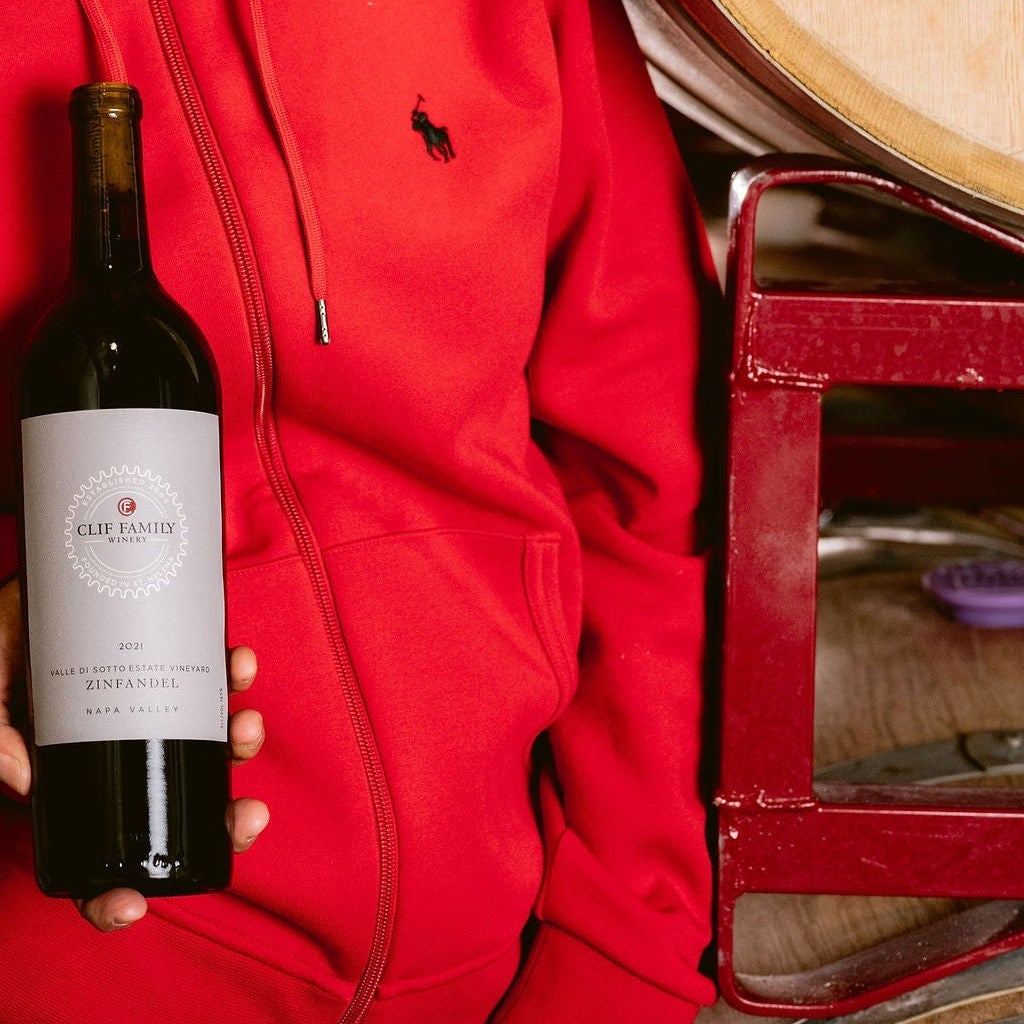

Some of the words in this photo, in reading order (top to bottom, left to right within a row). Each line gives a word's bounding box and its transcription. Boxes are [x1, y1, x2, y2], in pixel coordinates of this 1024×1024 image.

[82, 476, 146, 506] ESTABLISHED
[77, 522, 114, 536] CLIF
[119, 522, 176, 535] FAMILY
[108, 536, 147, 544] WINERY
[81, 556, 118, 586] FOUNDED
[120, 580, 130, 588] IN
[118, 642, 144, 651] 2021
[50, 667, 75, 677] VALLE
[79, 666, 89, 675] DI
[93, 665, 126, 674] SOTTO
[129, 664, 166, 673] ESTATE
[170, 665, 211, 674] VINEYARD
[86, 678, 179, 690] ZINFANDEL
[87, 706, 120, 715] NAPA
[129, 705, 179, 713] VALLEY
